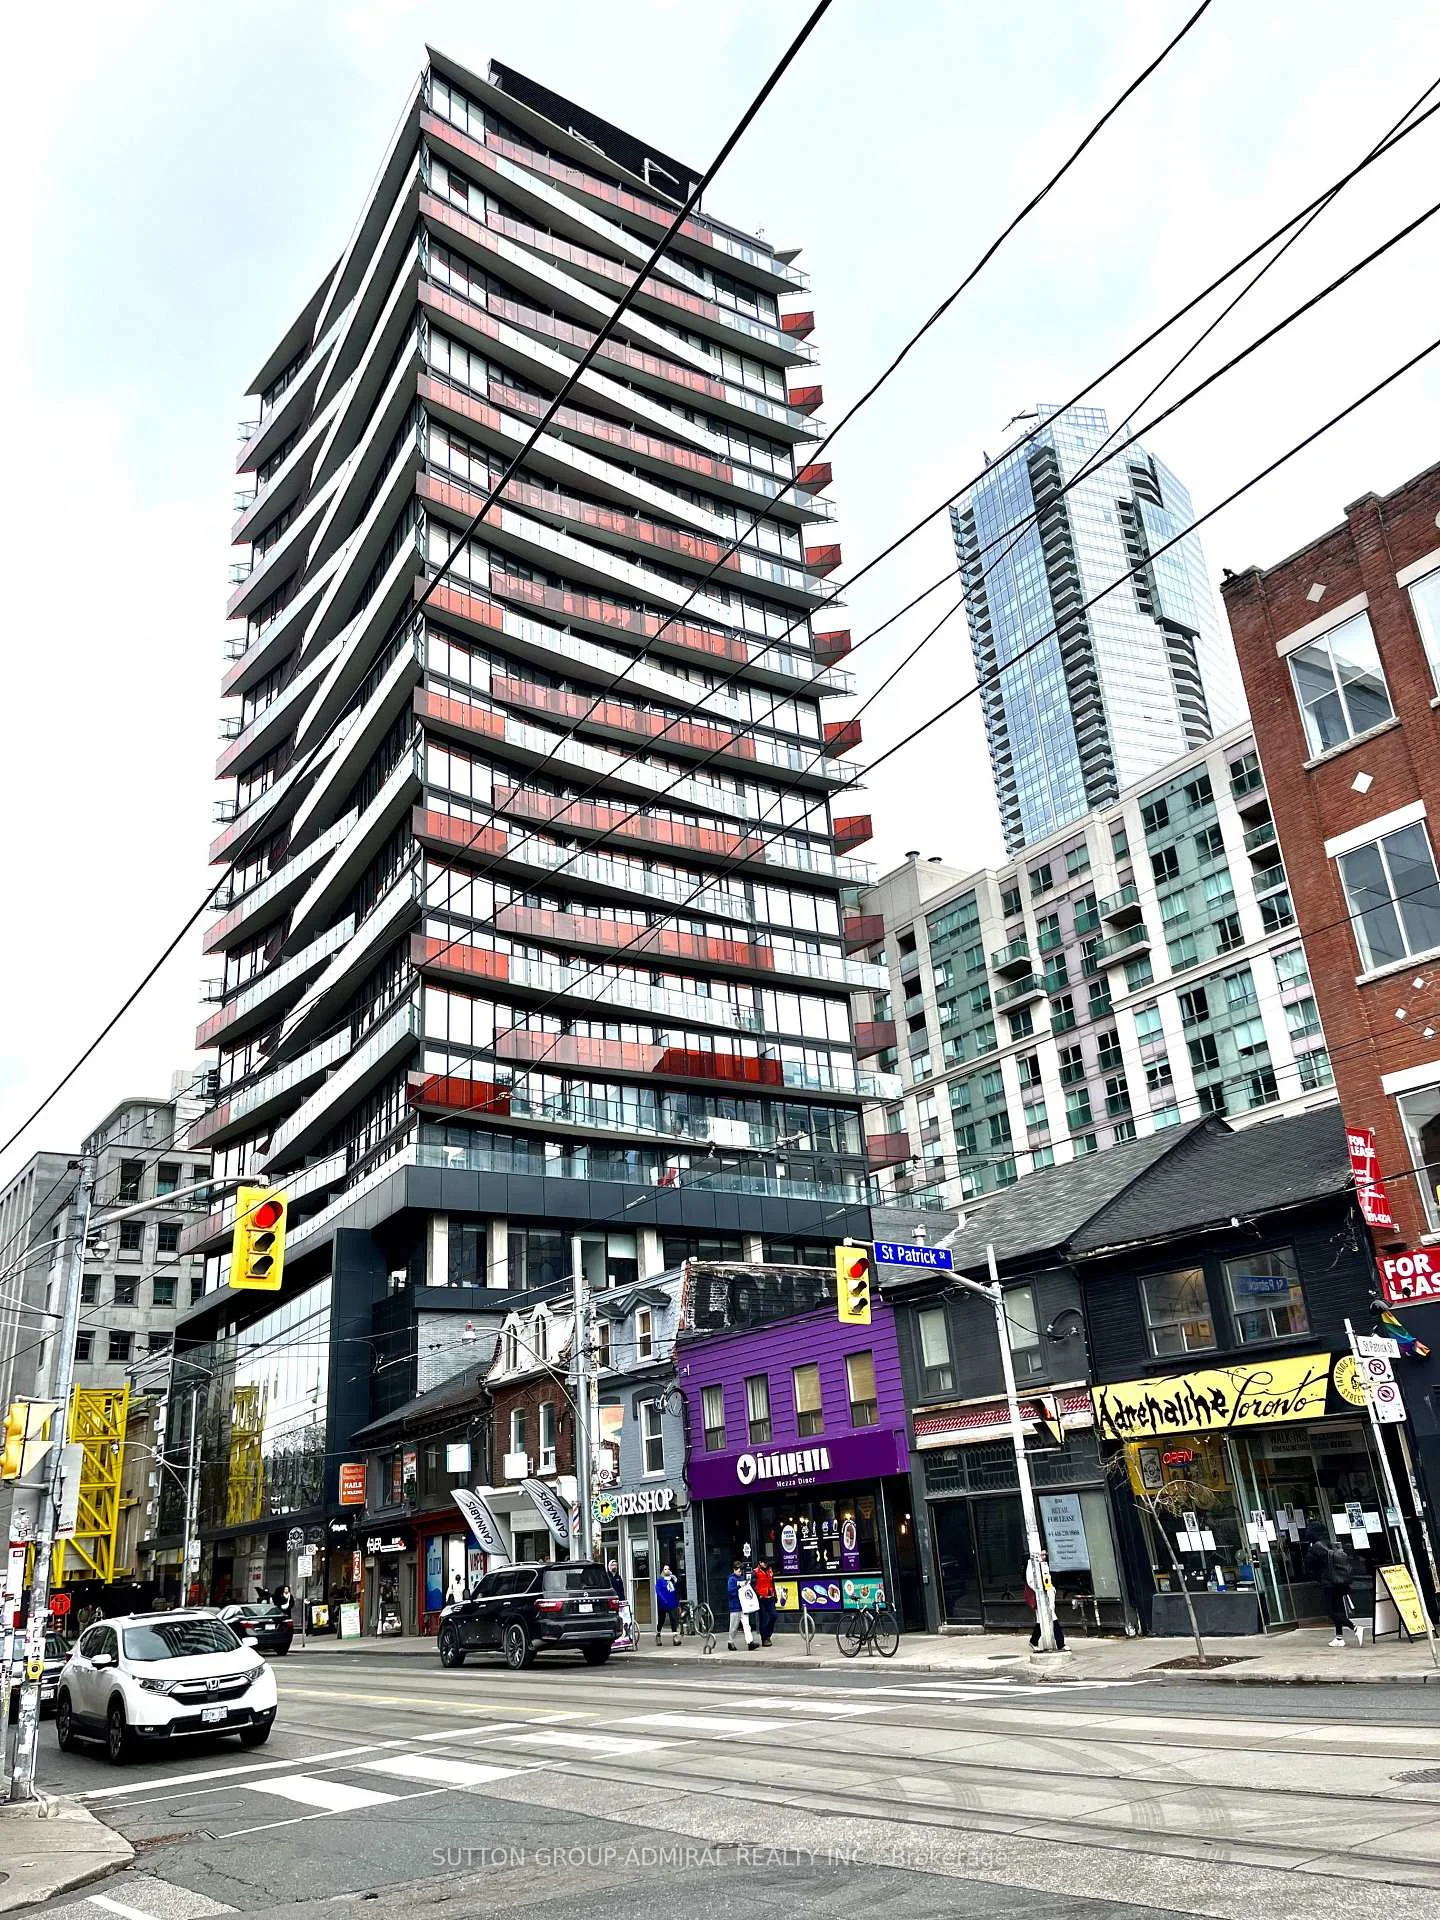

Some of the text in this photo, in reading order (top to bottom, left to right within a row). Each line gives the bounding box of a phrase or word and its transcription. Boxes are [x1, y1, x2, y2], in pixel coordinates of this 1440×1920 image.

[1348, 1135, 1366, 1147] FOR
[1350, 1145, 1376, 1158] LEASE
[881, 1244, 895, 1260] St
[897, 1246, 937, 1264] Patrick
[1383, 1253, 1433, 1280] FOR
[1099, 1366, 1330, 1440] Adrenaline Toronto
[1162, 1449, 1193, 1465] OPEN
[344, 1481, 362, 1489] NAILS
[798, 1477, 816, 1485] Diner
[614, 1487, 674, 1518] BERSHOP
[466, 1501, 494, 1545] CANNABIS
[540, 1491, 569, 1539] CANNABIS
[469, 1552, 484, 1572] VAPE
